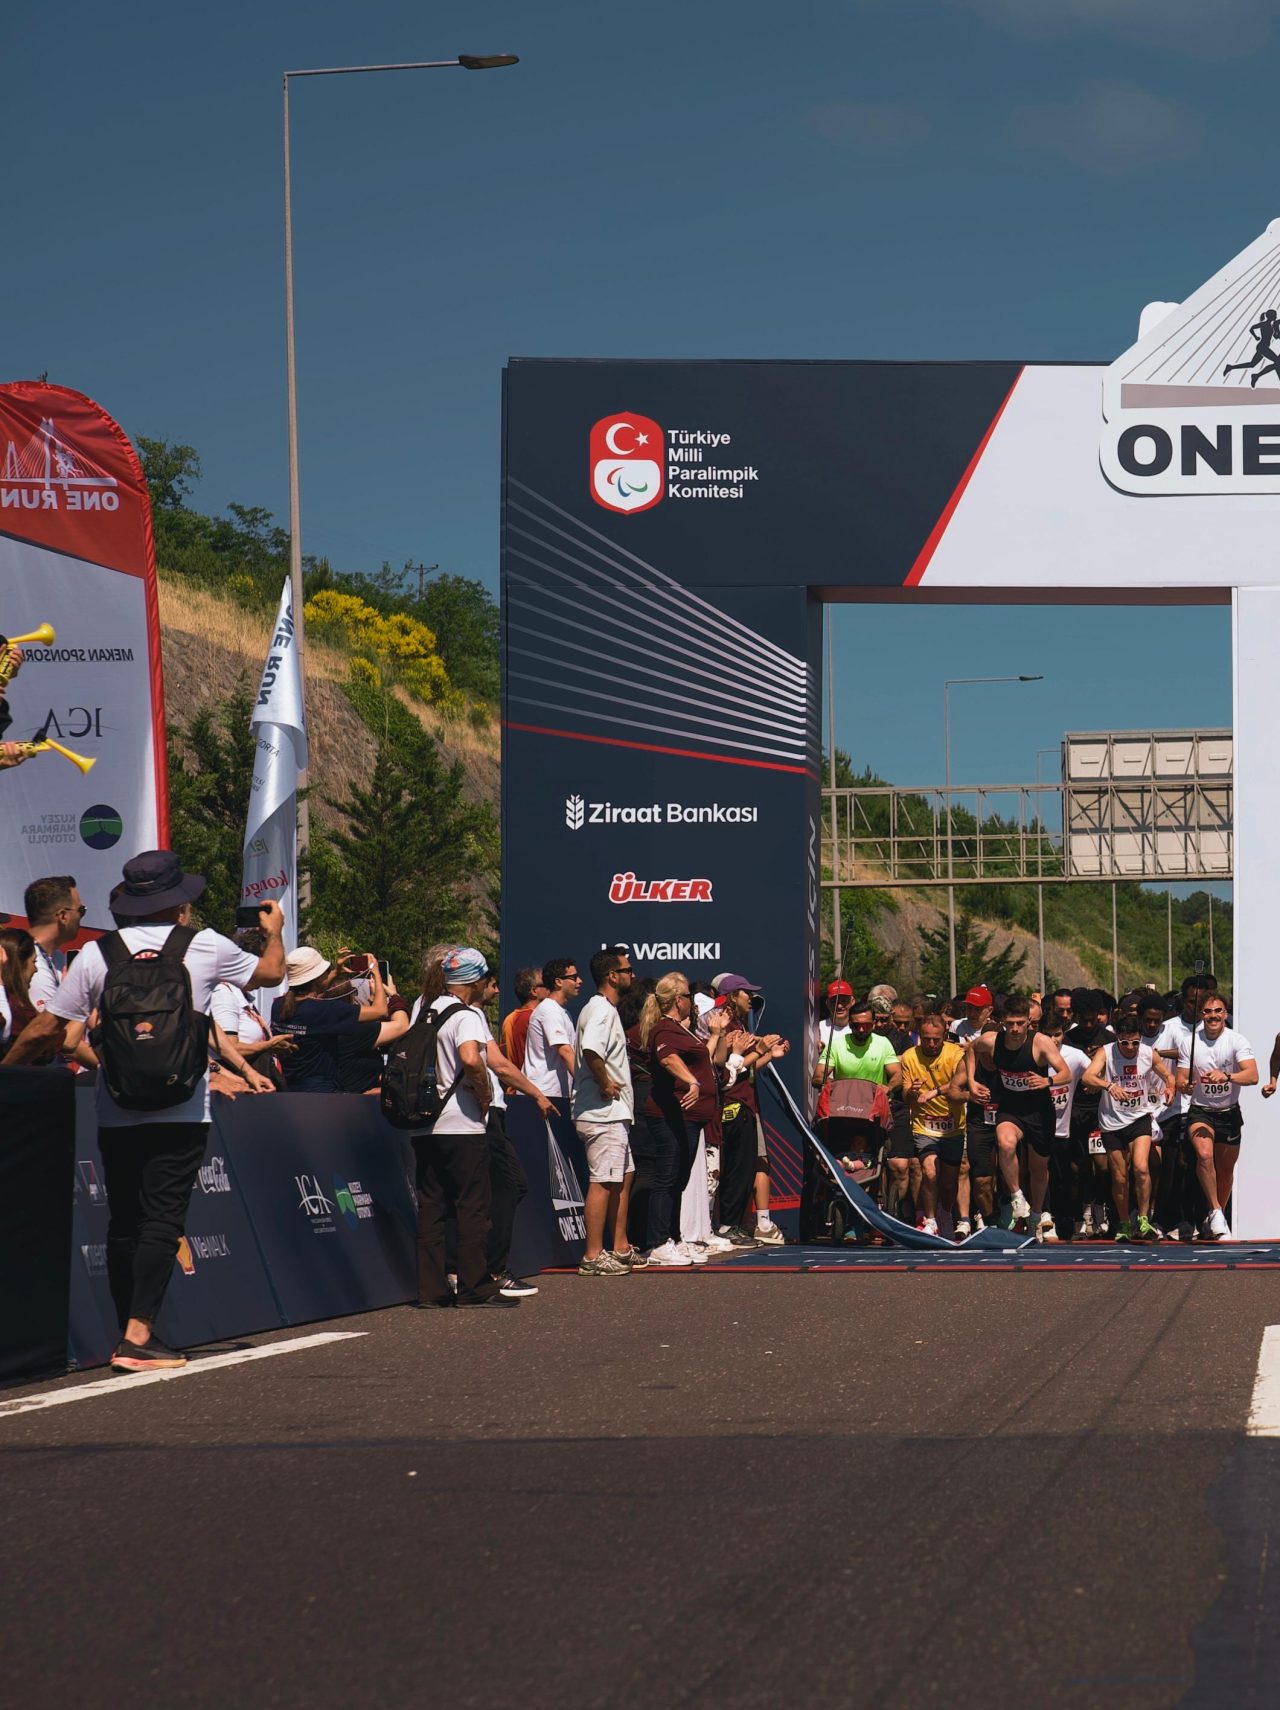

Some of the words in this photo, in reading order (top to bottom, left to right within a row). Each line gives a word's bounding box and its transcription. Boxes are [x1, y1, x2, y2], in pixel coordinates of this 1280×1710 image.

[668, 429, 731, 448] Türkiye
[668, 447, 703, 463] Milli
[668, 465, 759, 484] Paralimpik
[668, 483, 744, 499] Komitesi
[588, 801, 662, 824] Ziraat
[667, 803, 758, 824] Bankası
[609, 871, 714, 904] ÜLKER
[1204, 1083, 1230, 1095] 2096
[1091, 1139, 1102, 1148] 16
[294, 1174, 332, 1216] ICA
[558, 1216, 580, 1242] ONE
